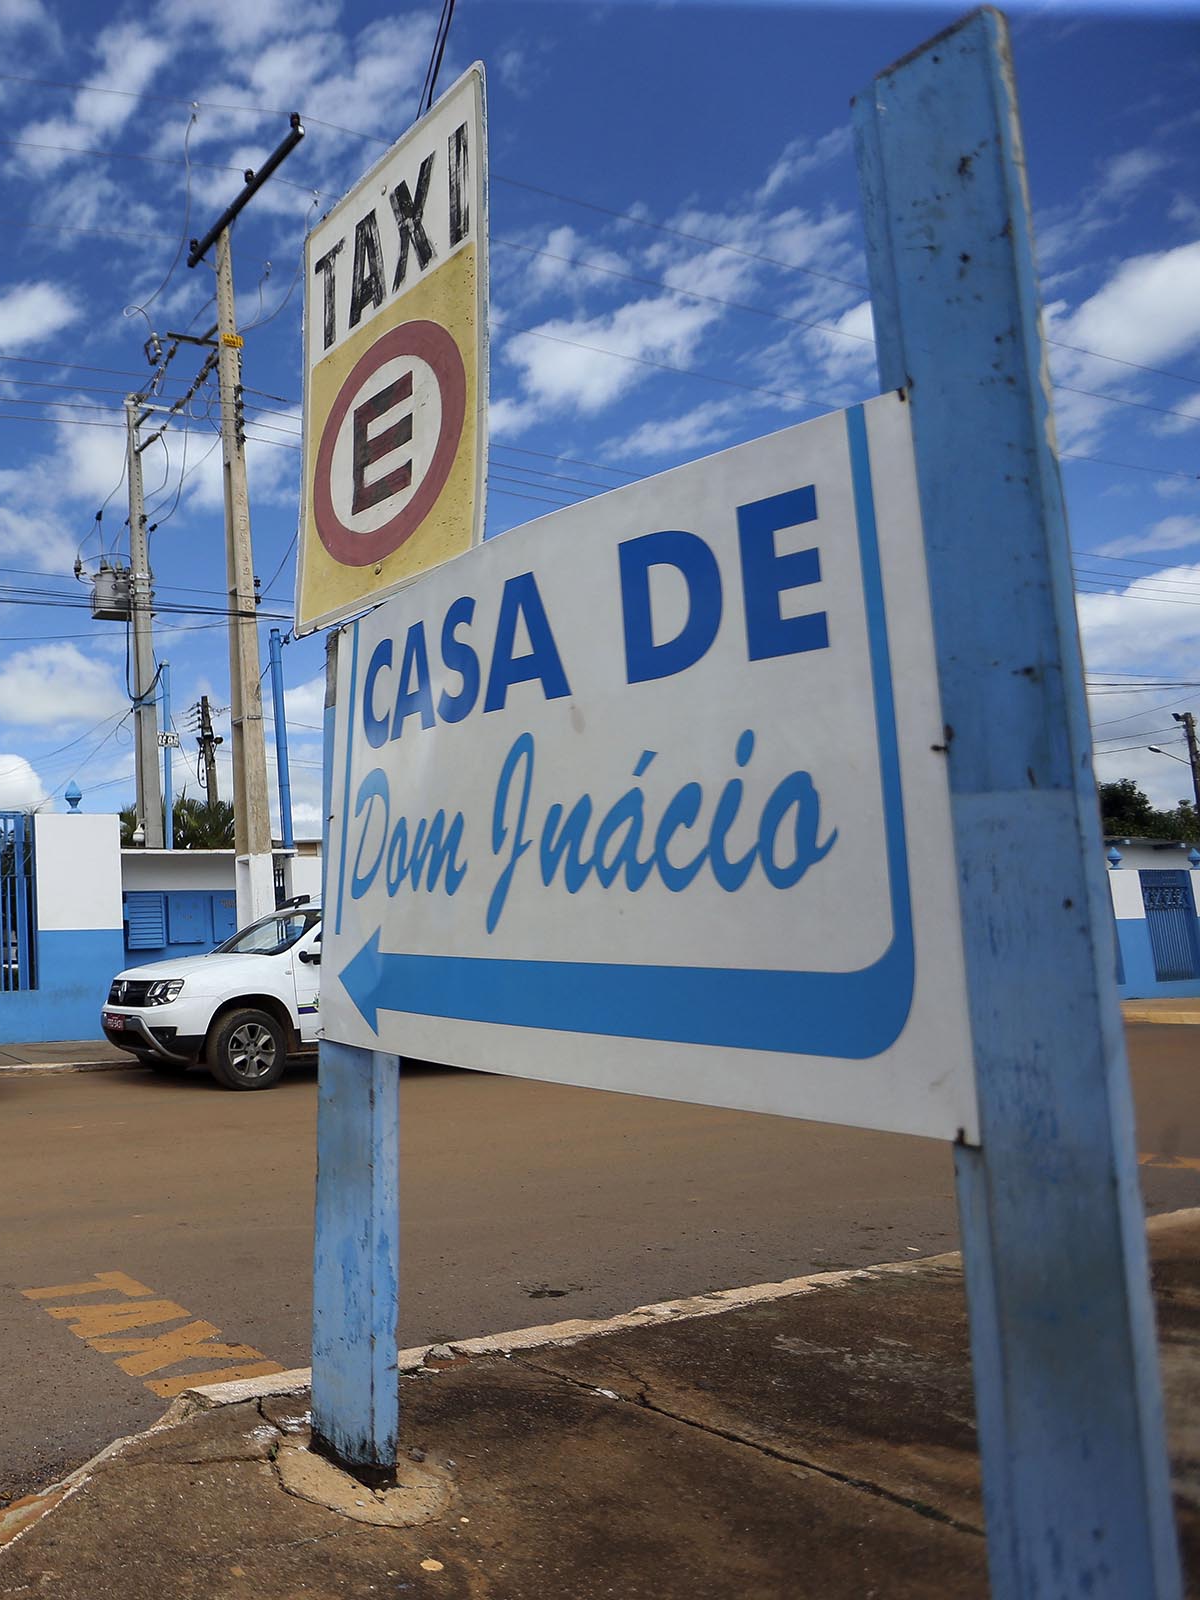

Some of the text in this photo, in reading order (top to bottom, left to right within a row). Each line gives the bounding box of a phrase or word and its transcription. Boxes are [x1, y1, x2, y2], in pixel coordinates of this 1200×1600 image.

[315, 121, 470, 351] TAXI
[352, 370, 414, 516] E
[362, 484, 830, 749] CASA DE
[351, 729, 839, 935] Dom Inácio
[19, 1271, 288, 1399] TAXI
